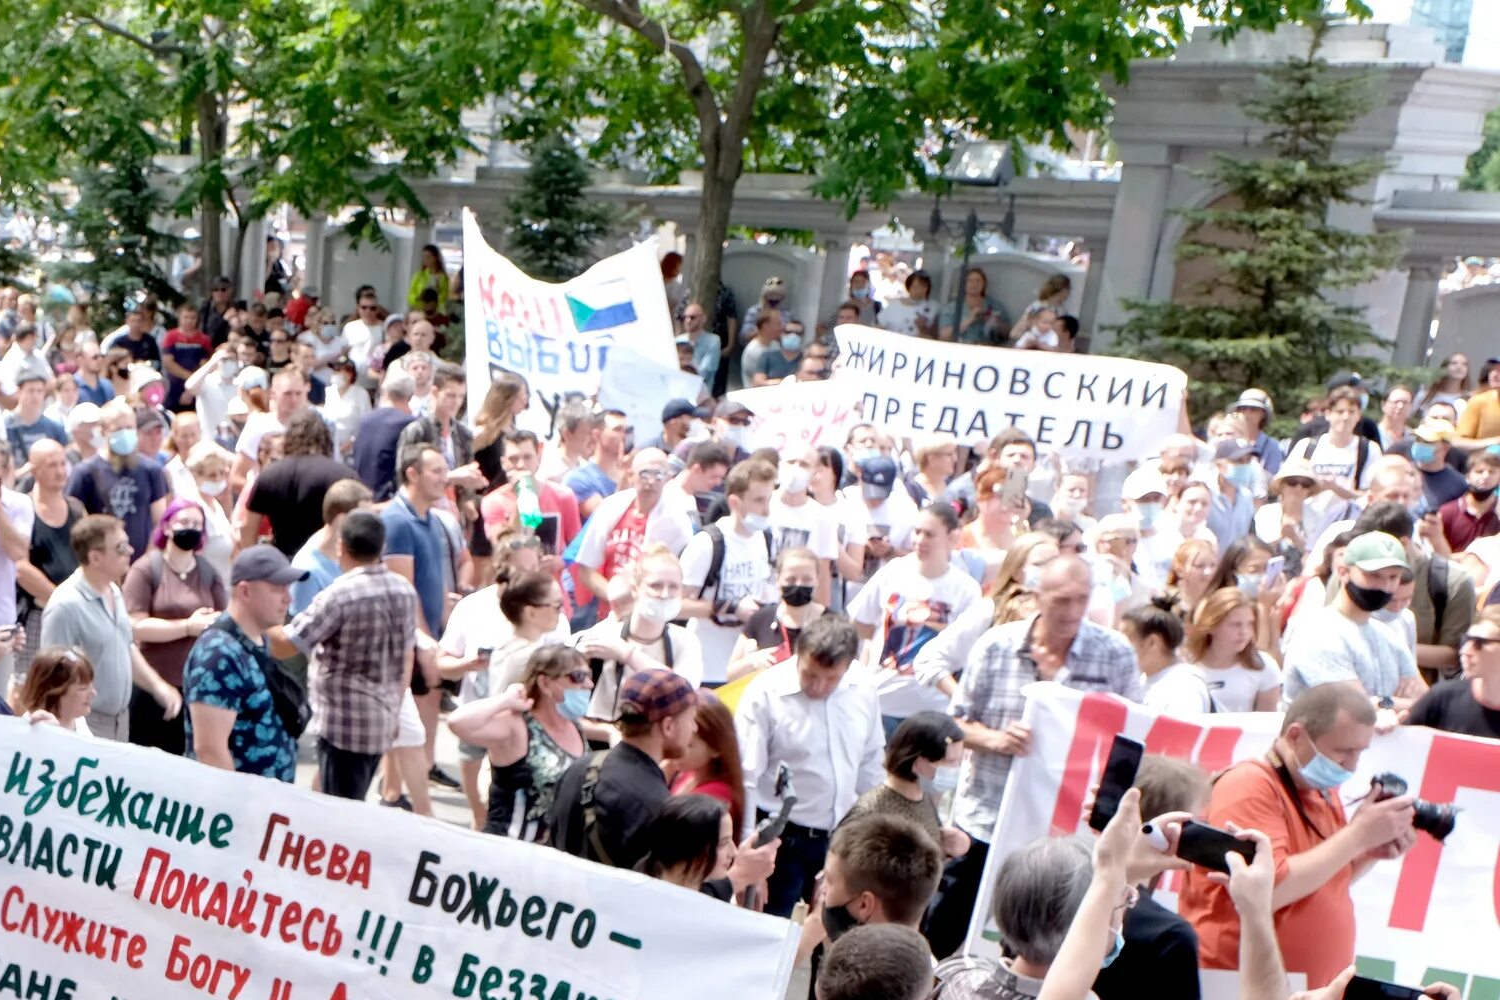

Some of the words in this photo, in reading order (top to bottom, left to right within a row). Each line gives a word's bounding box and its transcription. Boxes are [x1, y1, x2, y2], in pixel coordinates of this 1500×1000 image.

[860, 392, 1125, 450] ПРЕДАТЕЛЬ
[3, 751, 234, 849] избежание
[408, 850, 597, 949] Божьего
[0, 885, 147, 969] Служите
